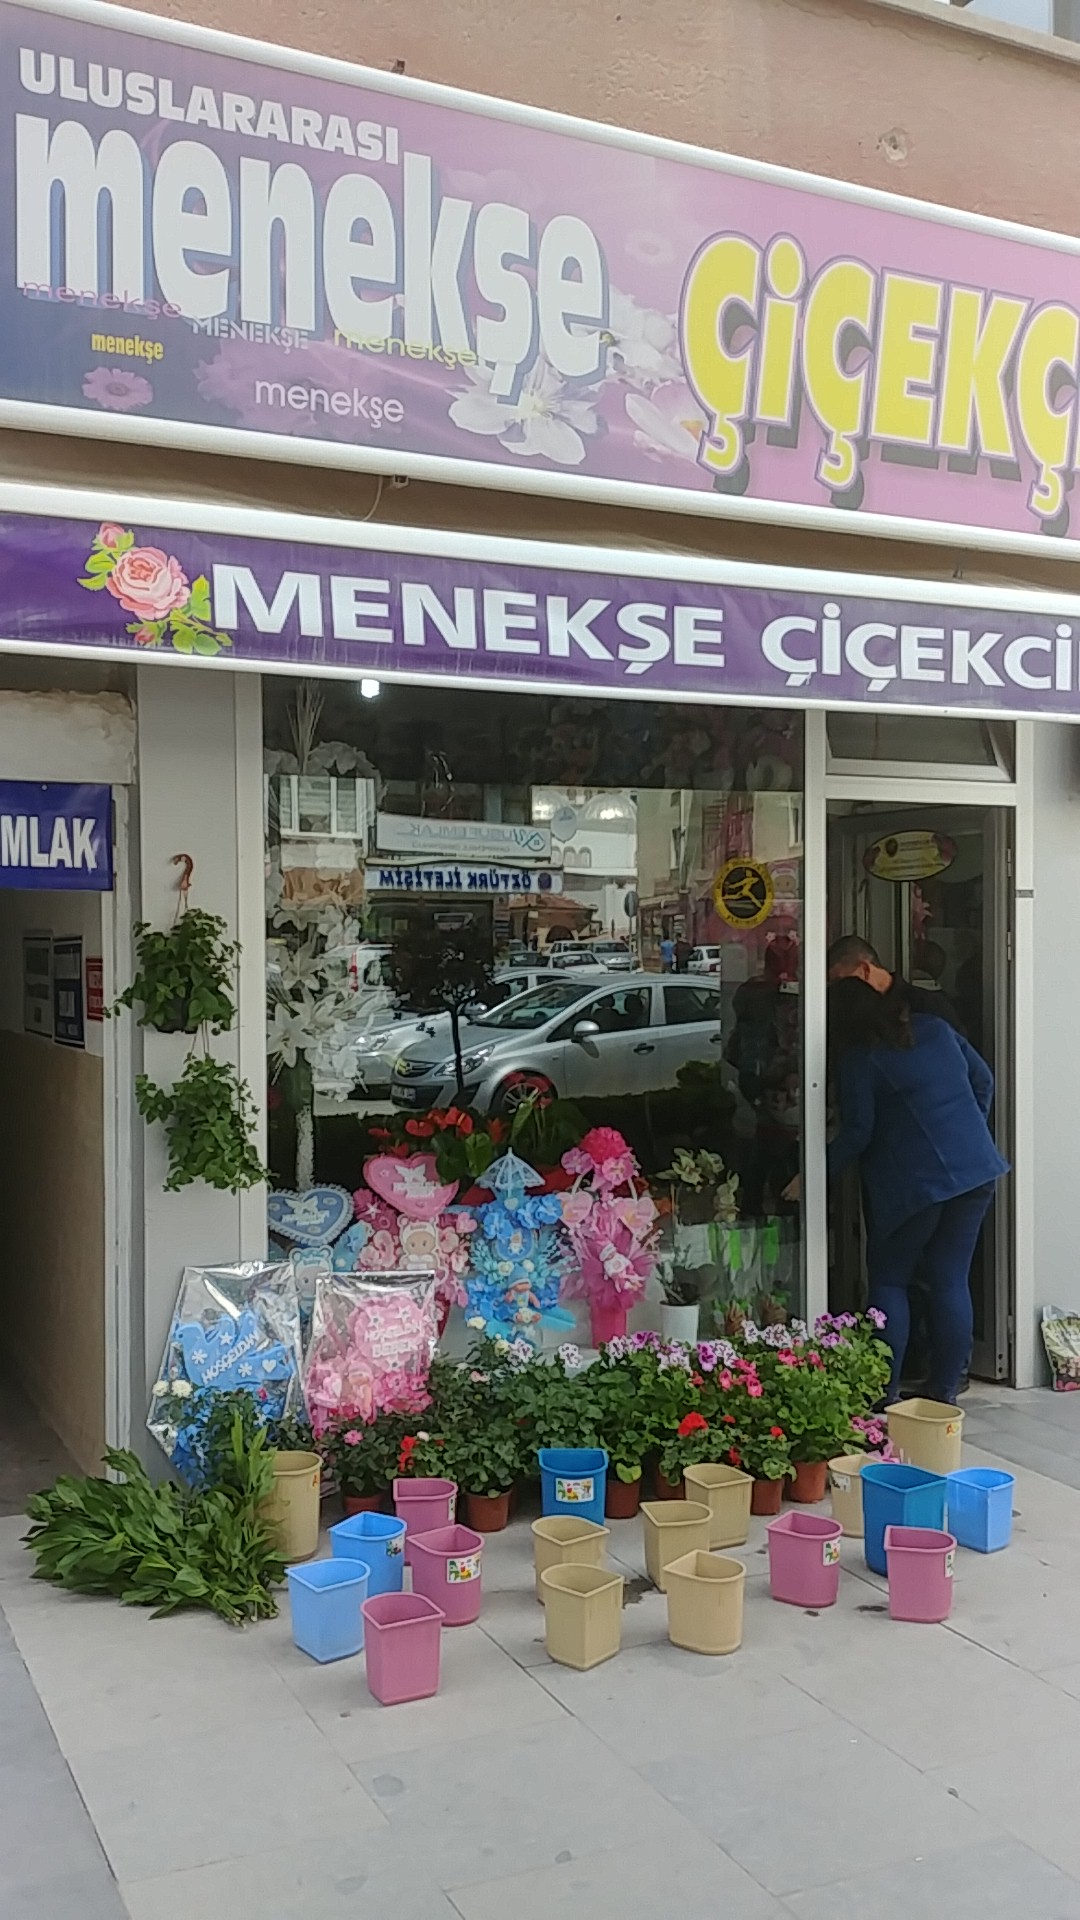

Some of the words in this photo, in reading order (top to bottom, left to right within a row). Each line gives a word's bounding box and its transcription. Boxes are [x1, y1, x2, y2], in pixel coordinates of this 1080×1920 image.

[19, 48, 400, 165] ULUSLARARASI
[16, 112, 606, 397] menekşe
[679, 229, 1080, 520] ÇİÇEKÇ
[22, 281, 182, 320] menekşe
[92, 333, 164, 364] menekşe
[193, 317, 310, 354] MENEKŞE
[333, 328, 479, 371] menekşe
[255, 379, 404, 428] menekşe
[212, 563, 725, 674] MENEKŞE
[761, 602, 1080, 692] ÇİÇEKCİ
